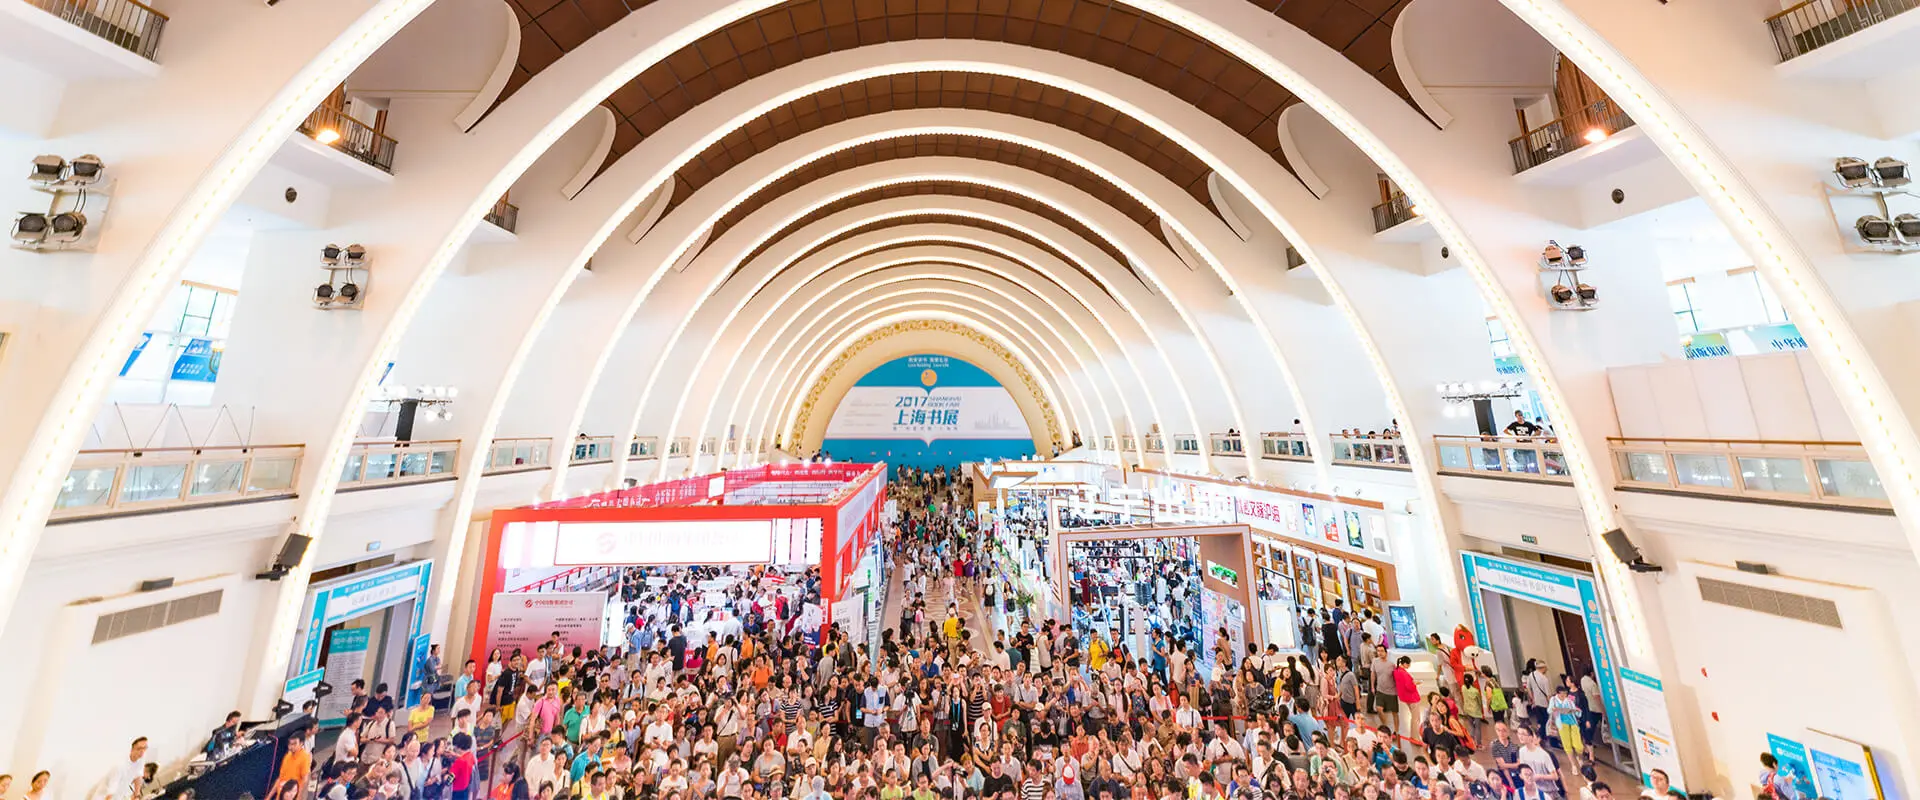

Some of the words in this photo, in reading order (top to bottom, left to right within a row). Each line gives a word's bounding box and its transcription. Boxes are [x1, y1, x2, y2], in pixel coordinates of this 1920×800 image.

[895, 396, 928, 407] 2017
[897, 409, 959, 425] 上海书展
